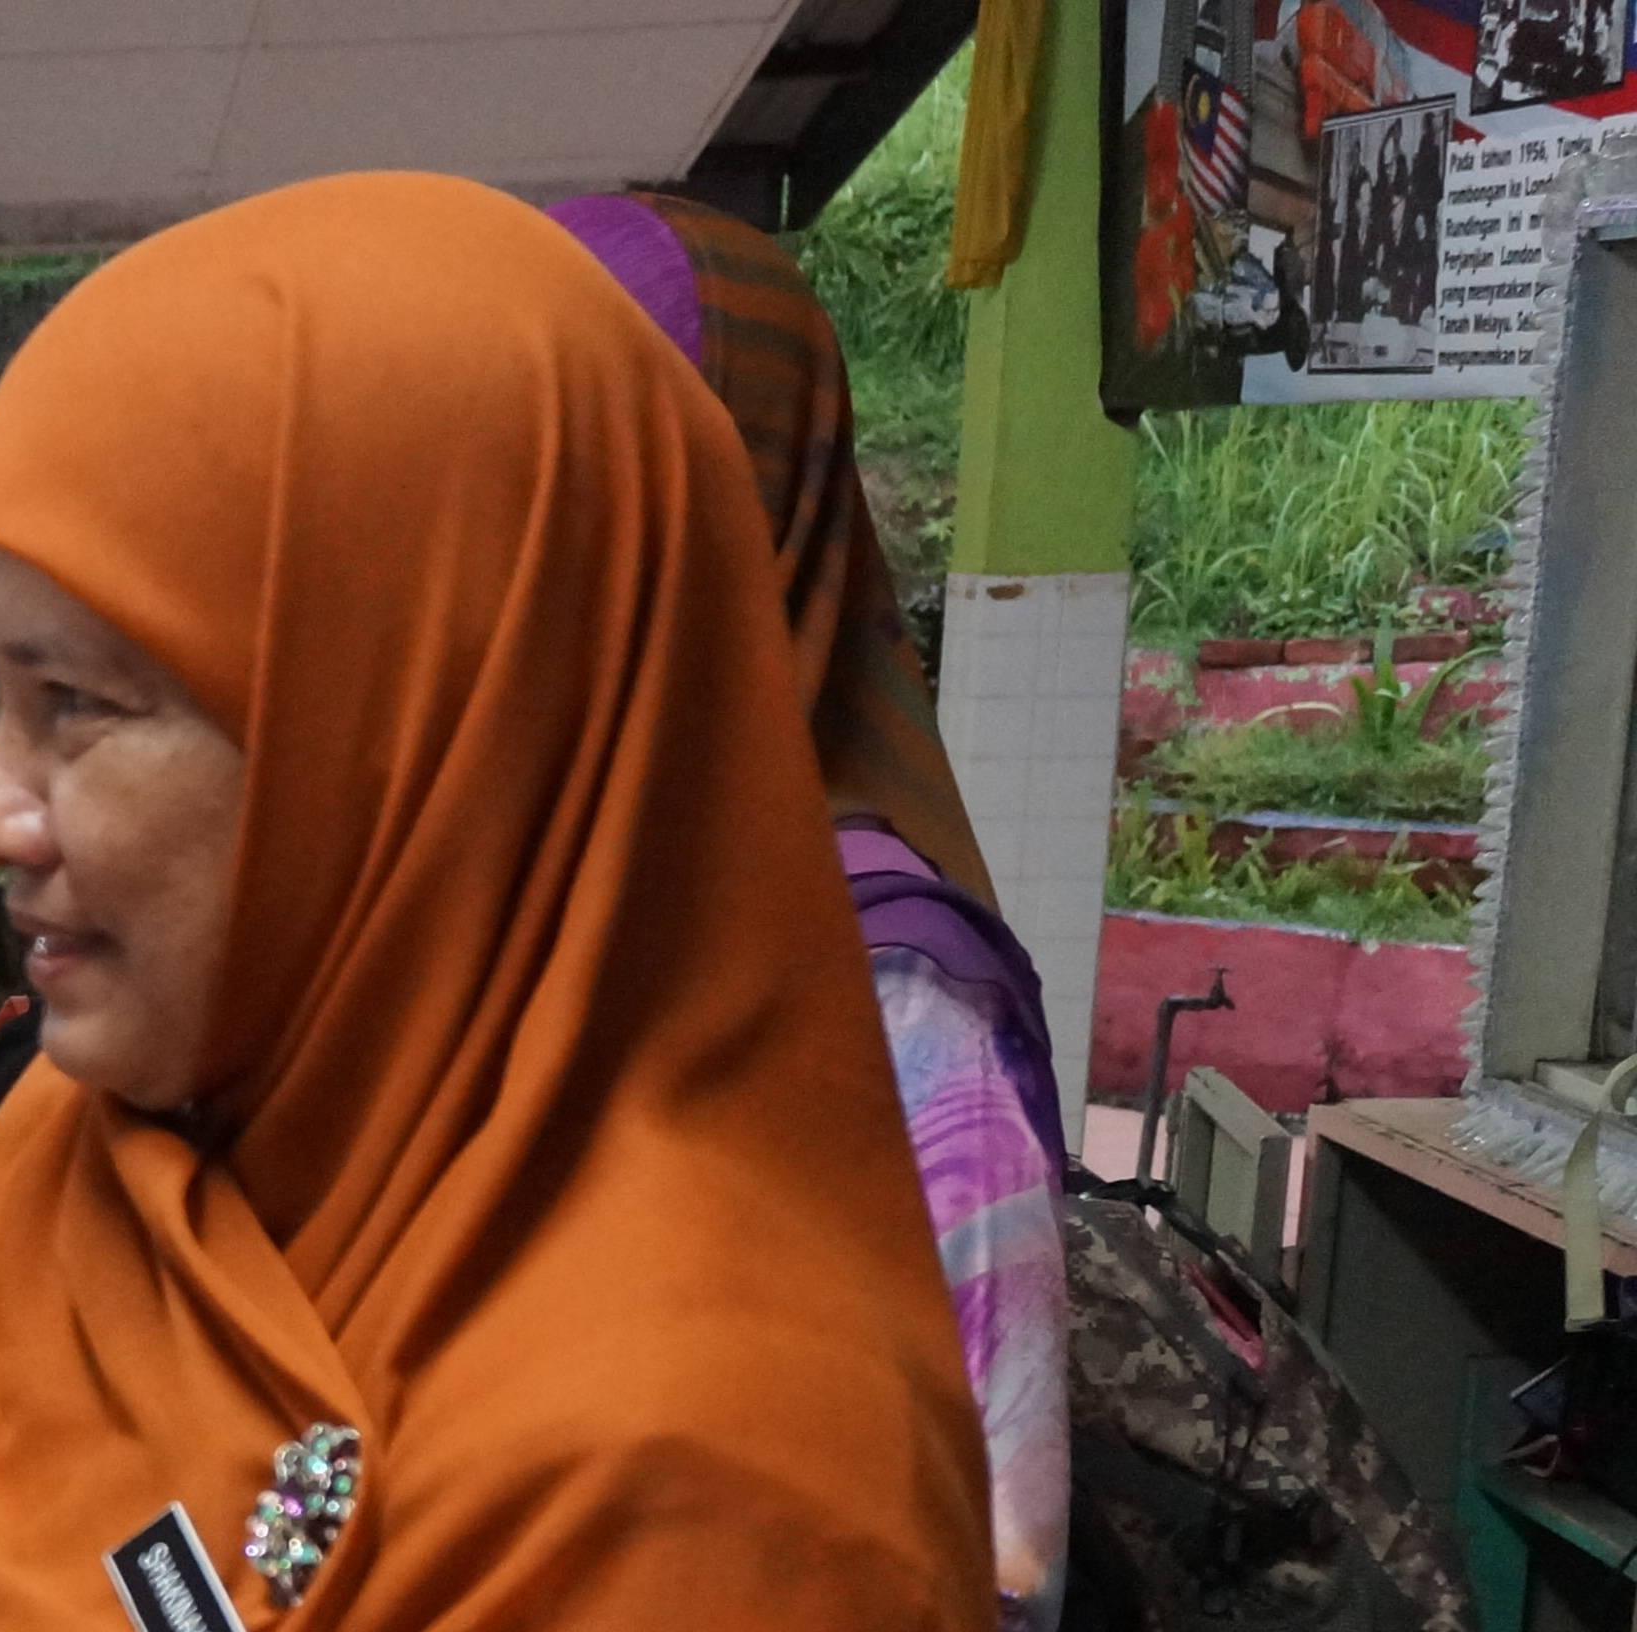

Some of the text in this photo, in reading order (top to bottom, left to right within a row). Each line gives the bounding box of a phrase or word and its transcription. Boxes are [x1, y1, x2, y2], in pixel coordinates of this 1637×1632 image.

[1449, 153, 1474, 173] Pada
[1520, 141, 1548, 163] 1956,
[1500, 244, 1542, 266] London
